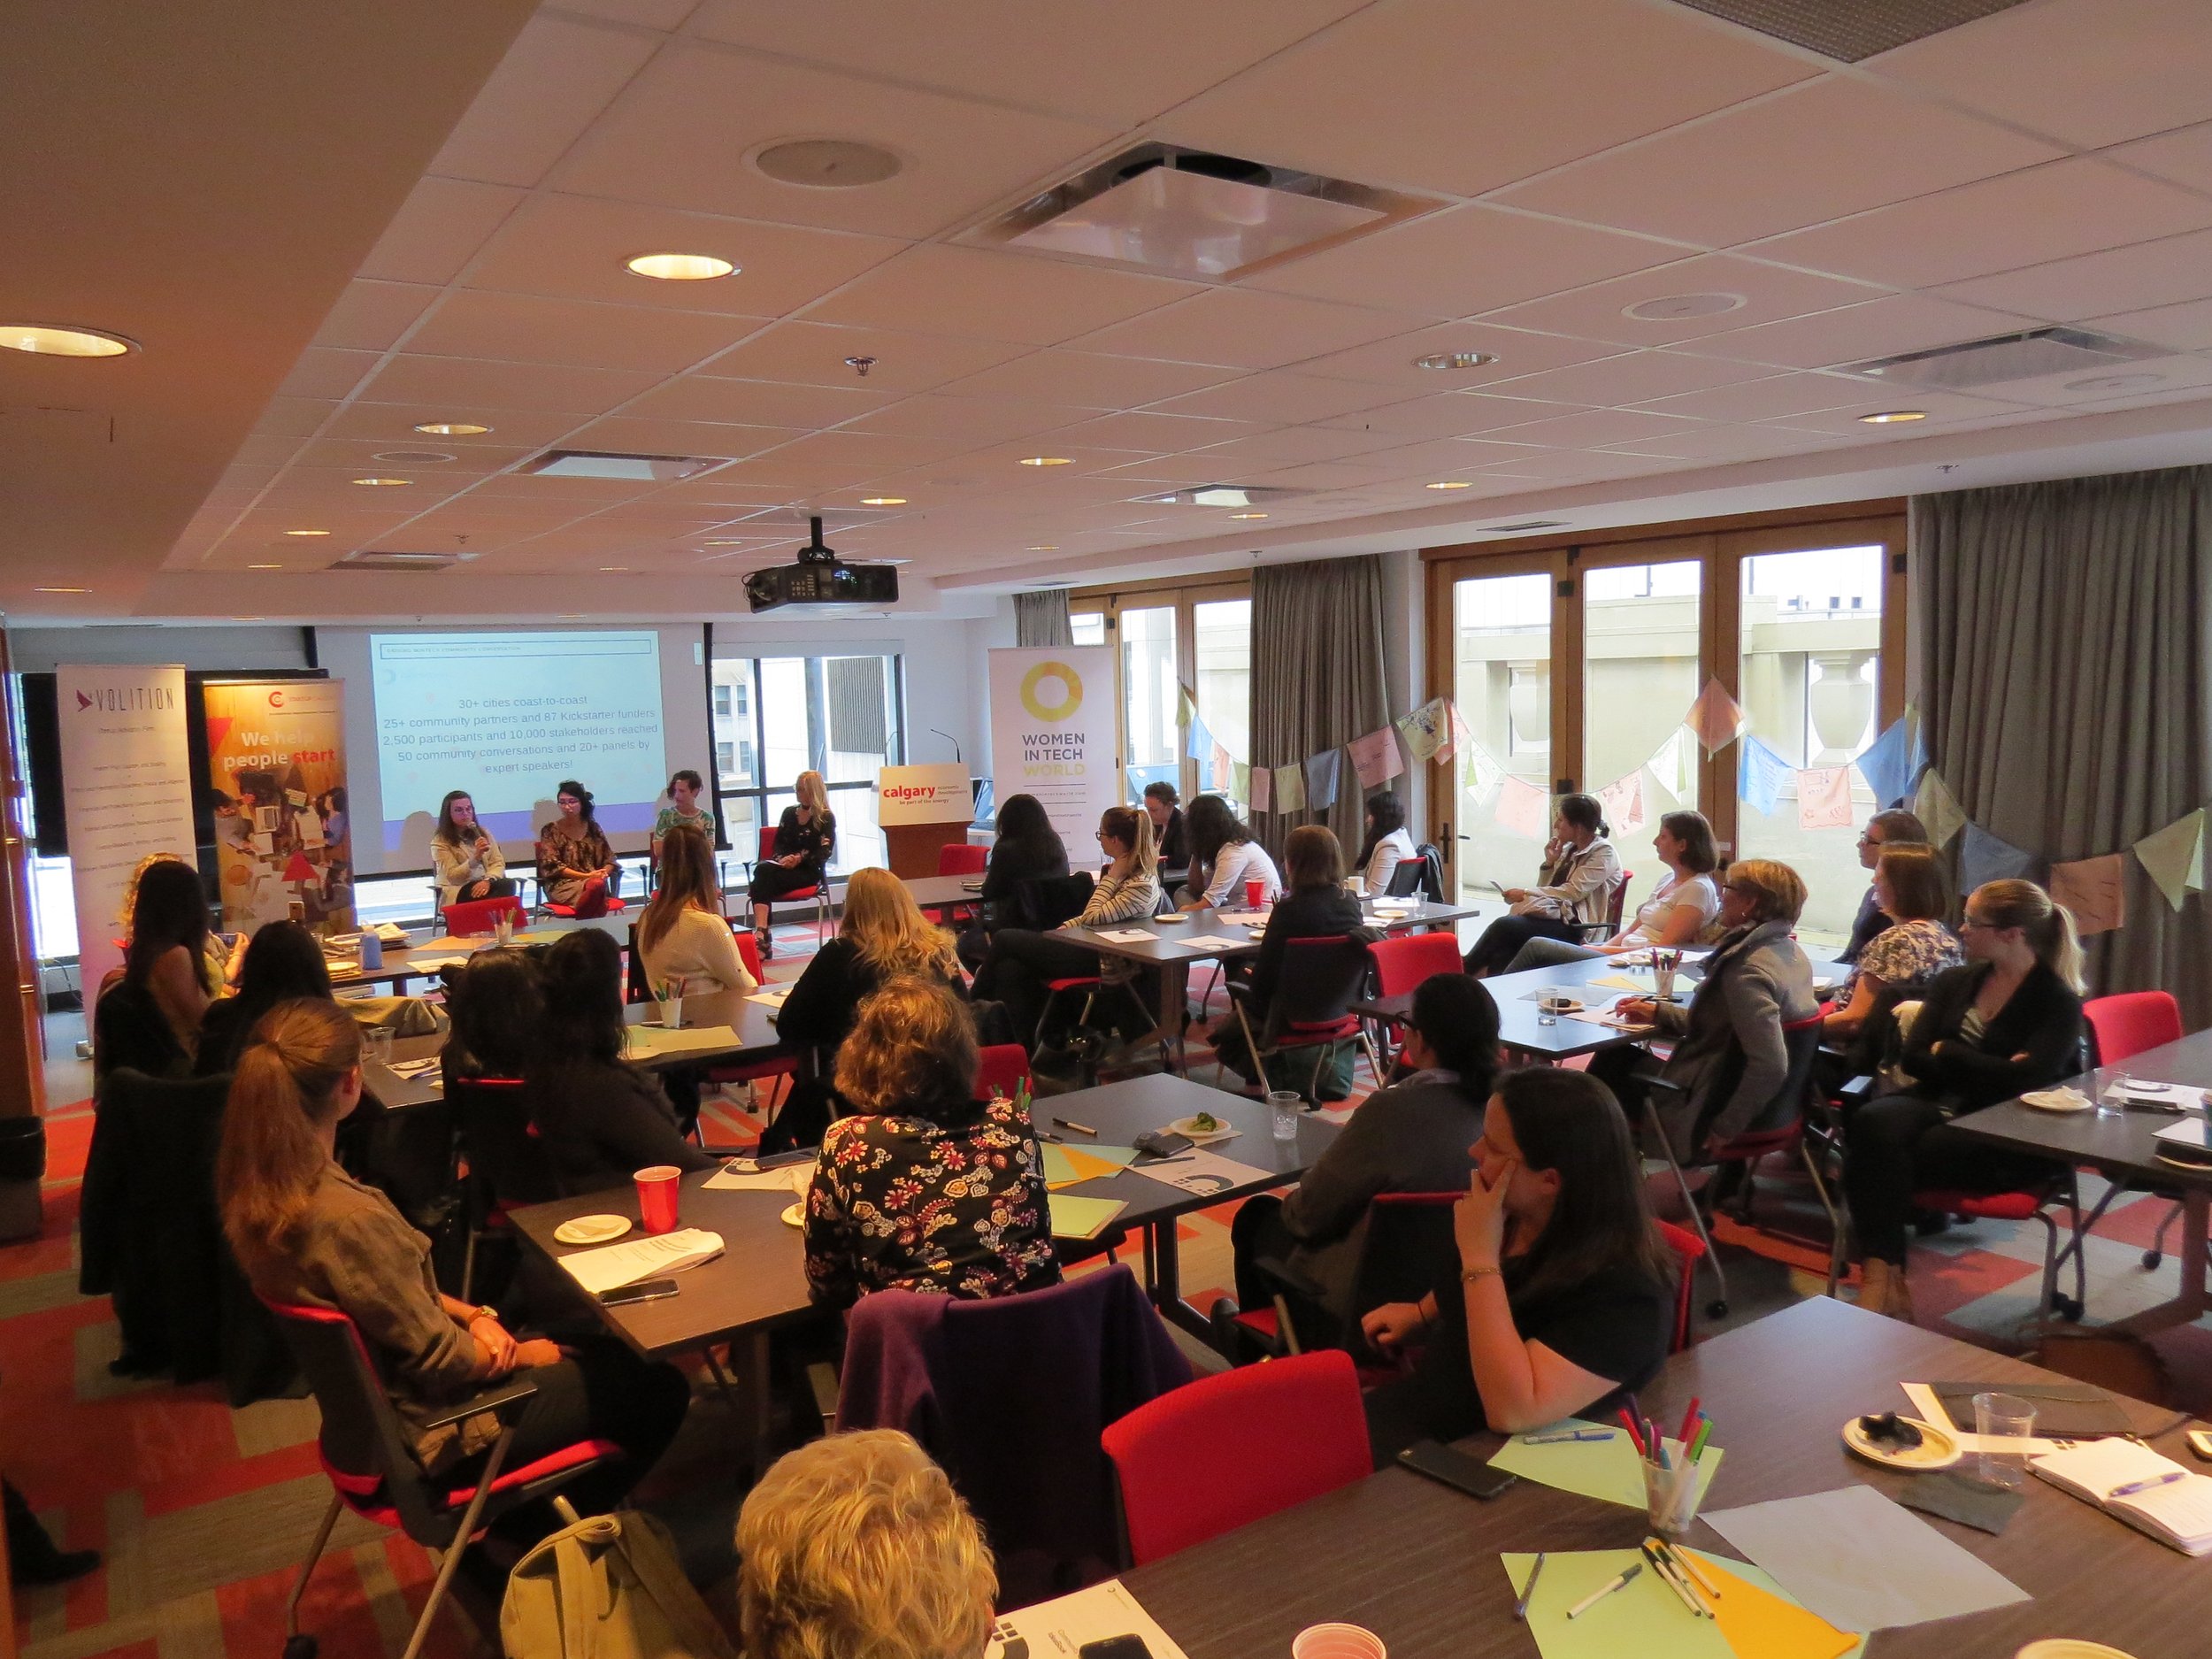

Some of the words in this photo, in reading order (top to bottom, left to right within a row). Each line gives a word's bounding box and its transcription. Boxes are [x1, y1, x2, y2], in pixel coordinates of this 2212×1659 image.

[96, 688, 173, 710] VOLITION
[458, 700, 480, 709] 30+
[482, 698, 511, 708] cities
[513, 695, 588, 707] coast-to-coast
[383, 719, 406, 729] 25+
[409, 717, 470, 728] community
[473, 714, 518, 726] partners
[521, 713, 541, 723] and
[544, 712, 557, 722] 87
[561, 710, 615, 720] Kickstarter
[618, 709, 655, 718] funders
[242, 733, 269, 746] We
[274, 729, 313, 746] help
[383, 735, 415, 746] 2,500
[419, 733, 482, 745] participants
[487, 731, 506, 740] and
[510, 729, 546, 740] 10,000
[549, 726, 615, 738] stakeholders
[618, 724, 658, 735] reached
[1022, 733, 1085, 746] WOMEN
[398, 752, 412, 762] 50
[416, 749, 476, 761] community
[480, 745, 554, 757] conversations
[557, 743, 576, 753] and
[580, 742, 598, 752] 20+
[602, 740, 635, 751] panels
[638, 740, 649, 750] by
[1025, 750, 1039, 761] IN
[1043, 749, 1083, 760] TECH
[224, 751, 288, 772] people
[293, 749, 335, 764] start
[486, 763, 519, 774] expert
[522, 761, 573, 772] speakers!
[1023, 764, 1085, 777] WORLD
[884, 786, 935, 800] calgary
